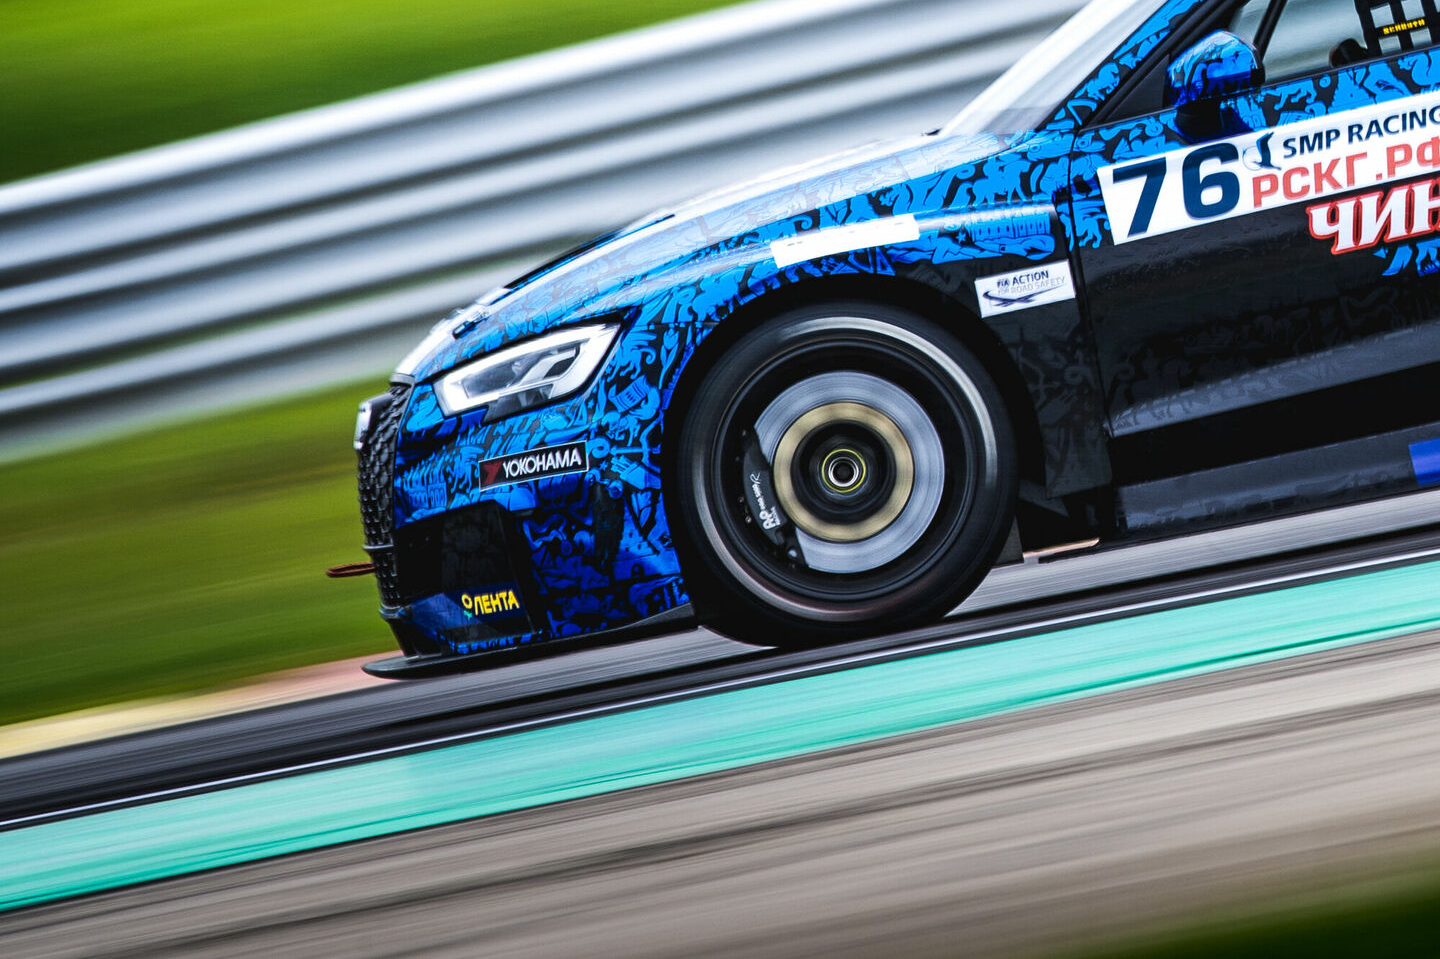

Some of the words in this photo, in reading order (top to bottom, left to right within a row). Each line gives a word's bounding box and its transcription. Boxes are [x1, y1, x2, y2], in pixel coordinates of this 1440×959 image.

[1283, 129, 1342, 159] SMP
[1112, 142, 1240, 239] 76
[1012, 270, 1049, 286] ACTION
[503, 447, 582, 479] YOKOHAMA
[474, 590, 520, 616] ЛЕНТА
